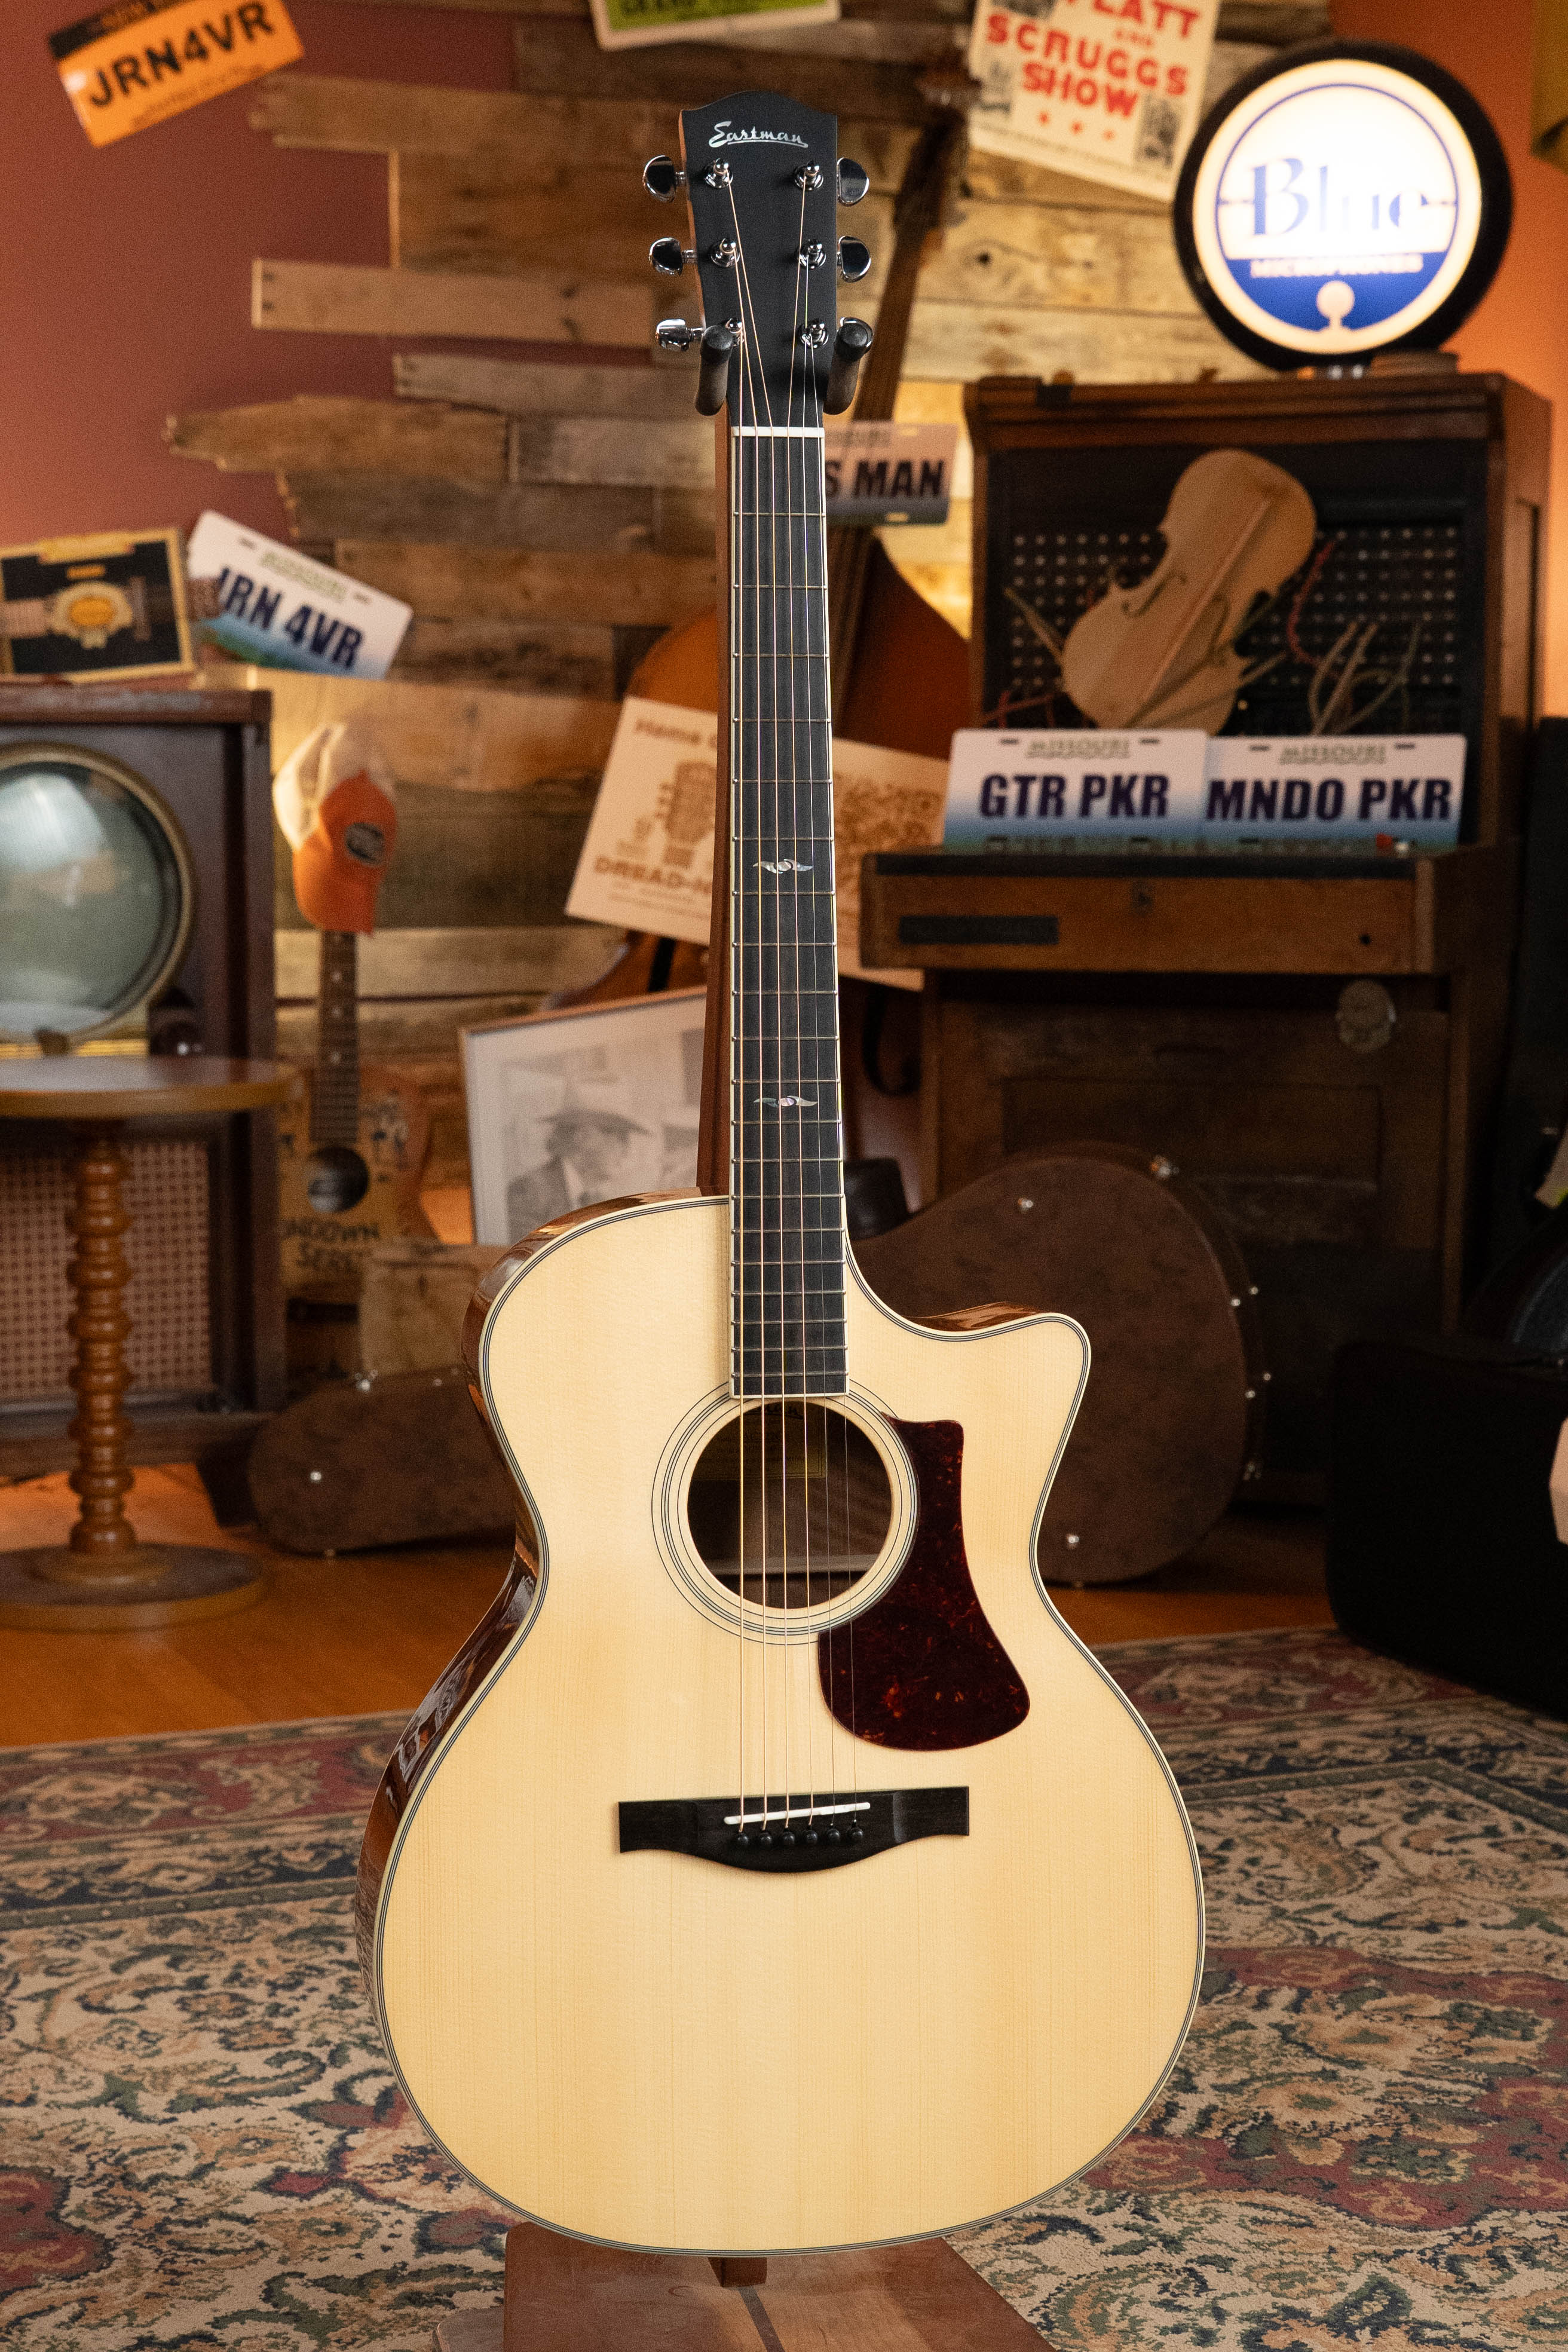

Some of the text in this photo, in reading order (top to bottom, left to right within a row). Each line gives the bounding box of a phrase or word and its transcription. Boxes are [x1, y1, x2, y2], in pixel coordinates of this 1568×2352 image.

[90, 1, 274, 108] JRN4VR
[986, 13, 1189, 96] SCRUGGS
[1022, 62, 1138, 120] SHOW
[709, 121, 808, 148] Eastman
[1252, 157, 1430, 235] Blue
[853, 459, 945, 497] MAN
[284, 604, 364, 669] 4VR
[980, 774, 1067, 817] GTR
[1079, 774, 1170, 817] PKR
[1205, 778, 1452, 821] MNDO PKR
